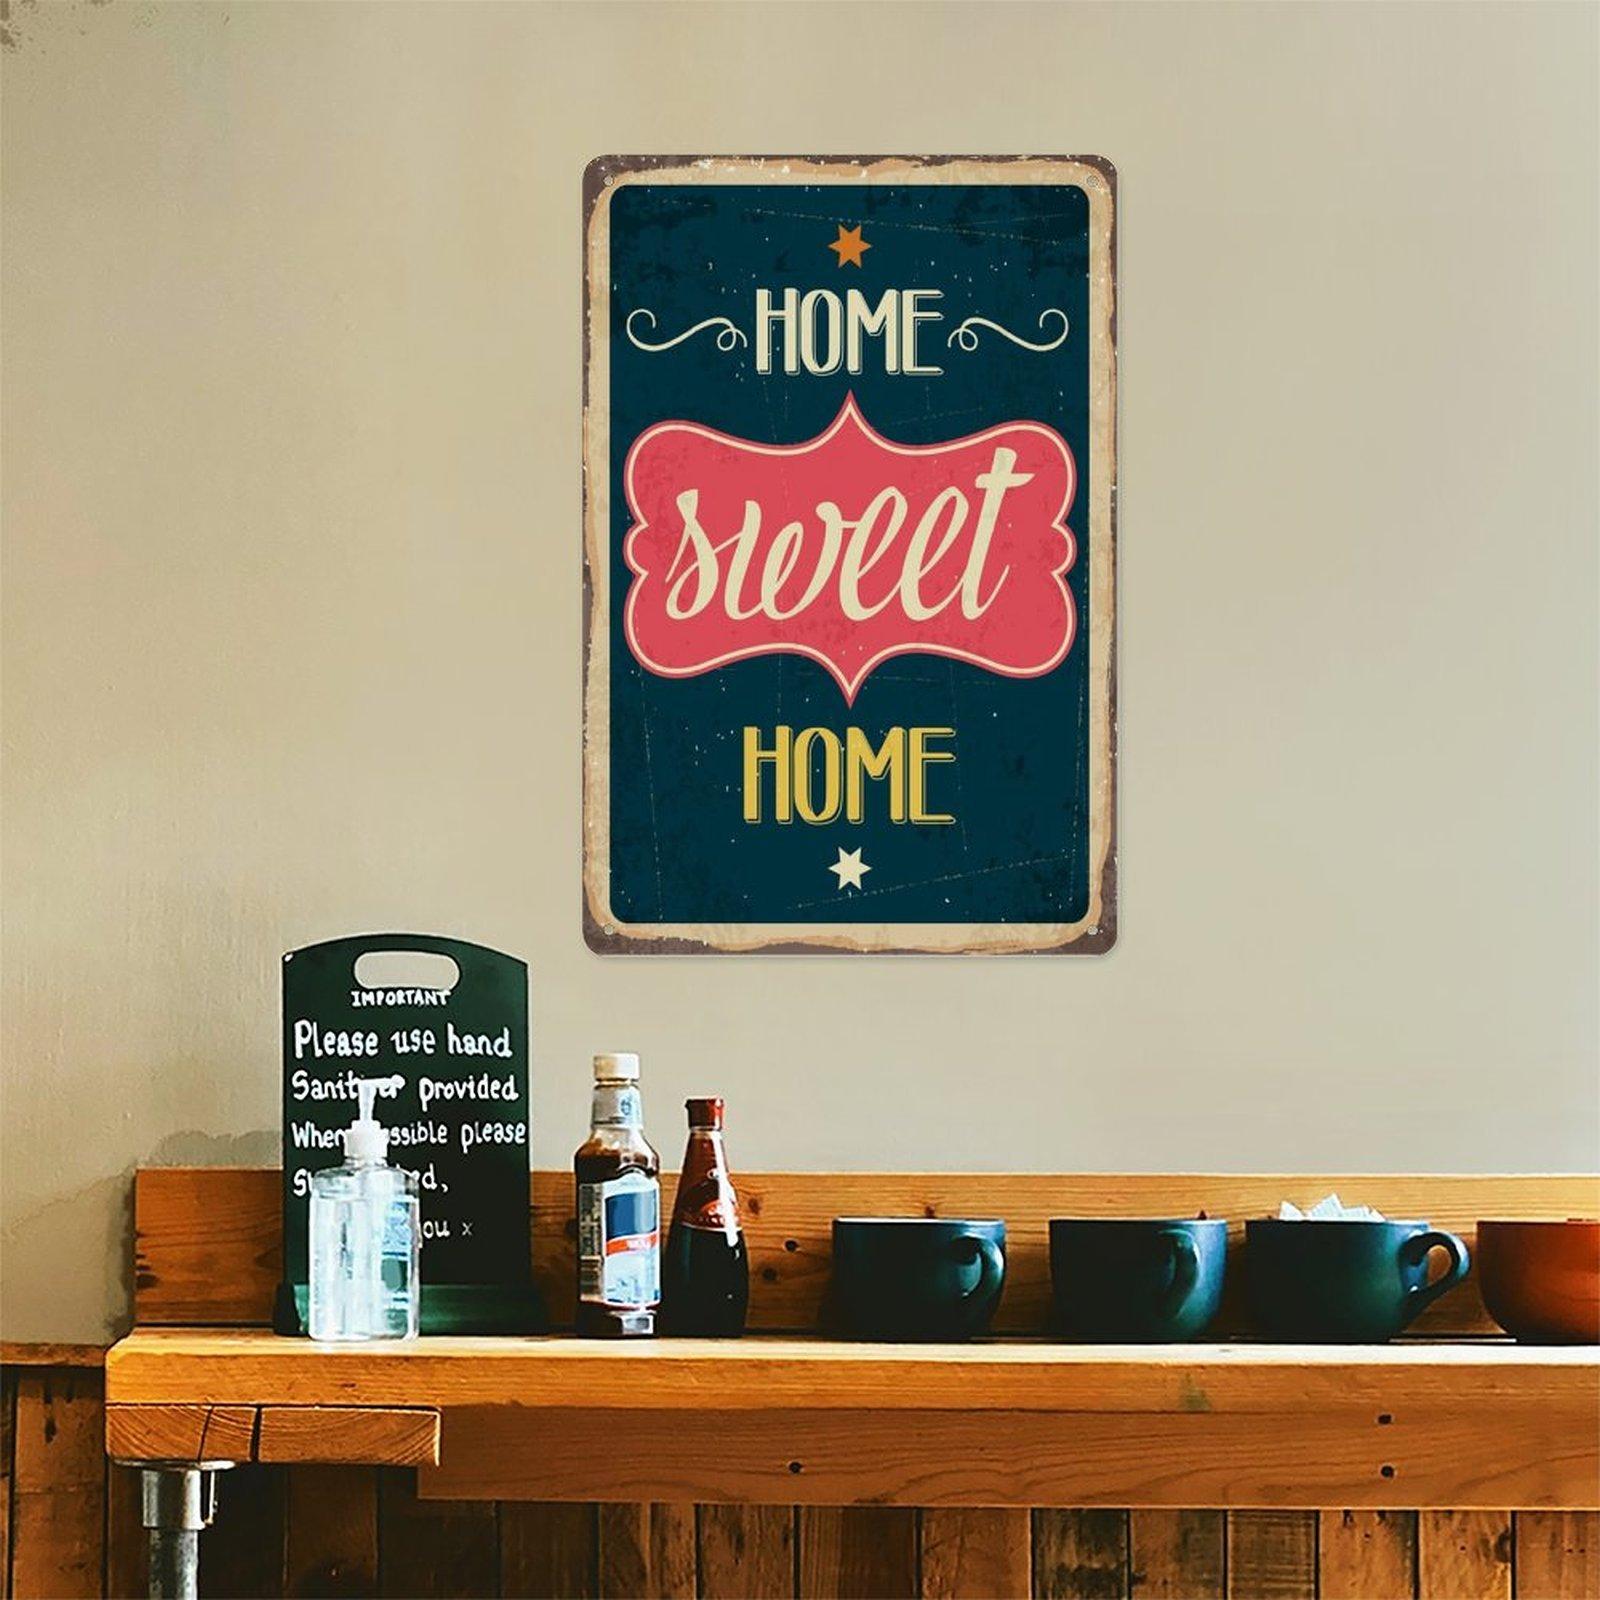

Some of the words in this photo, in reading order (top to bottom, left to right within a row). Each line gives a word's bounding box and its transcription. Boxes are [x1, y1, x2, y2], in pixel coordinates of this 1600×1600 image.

[755, 288, 944, 377] HOME
[665, 446, 1035, 622] sweet
[743, 725, 957, 826] HOME
[351, 989, 452, 1007] IMPORTANT
[293, 1019, 379, 1059] Please
[391, 1028, 436, 1055] use
[447, 1022, 513, 1058] hand
[419, 1073, 519, 1113] provided
[366, 1122, 448, 1147] ssible
[461, 1121, 526, 1154] please
[415, 1219, 450, 1243] ou
